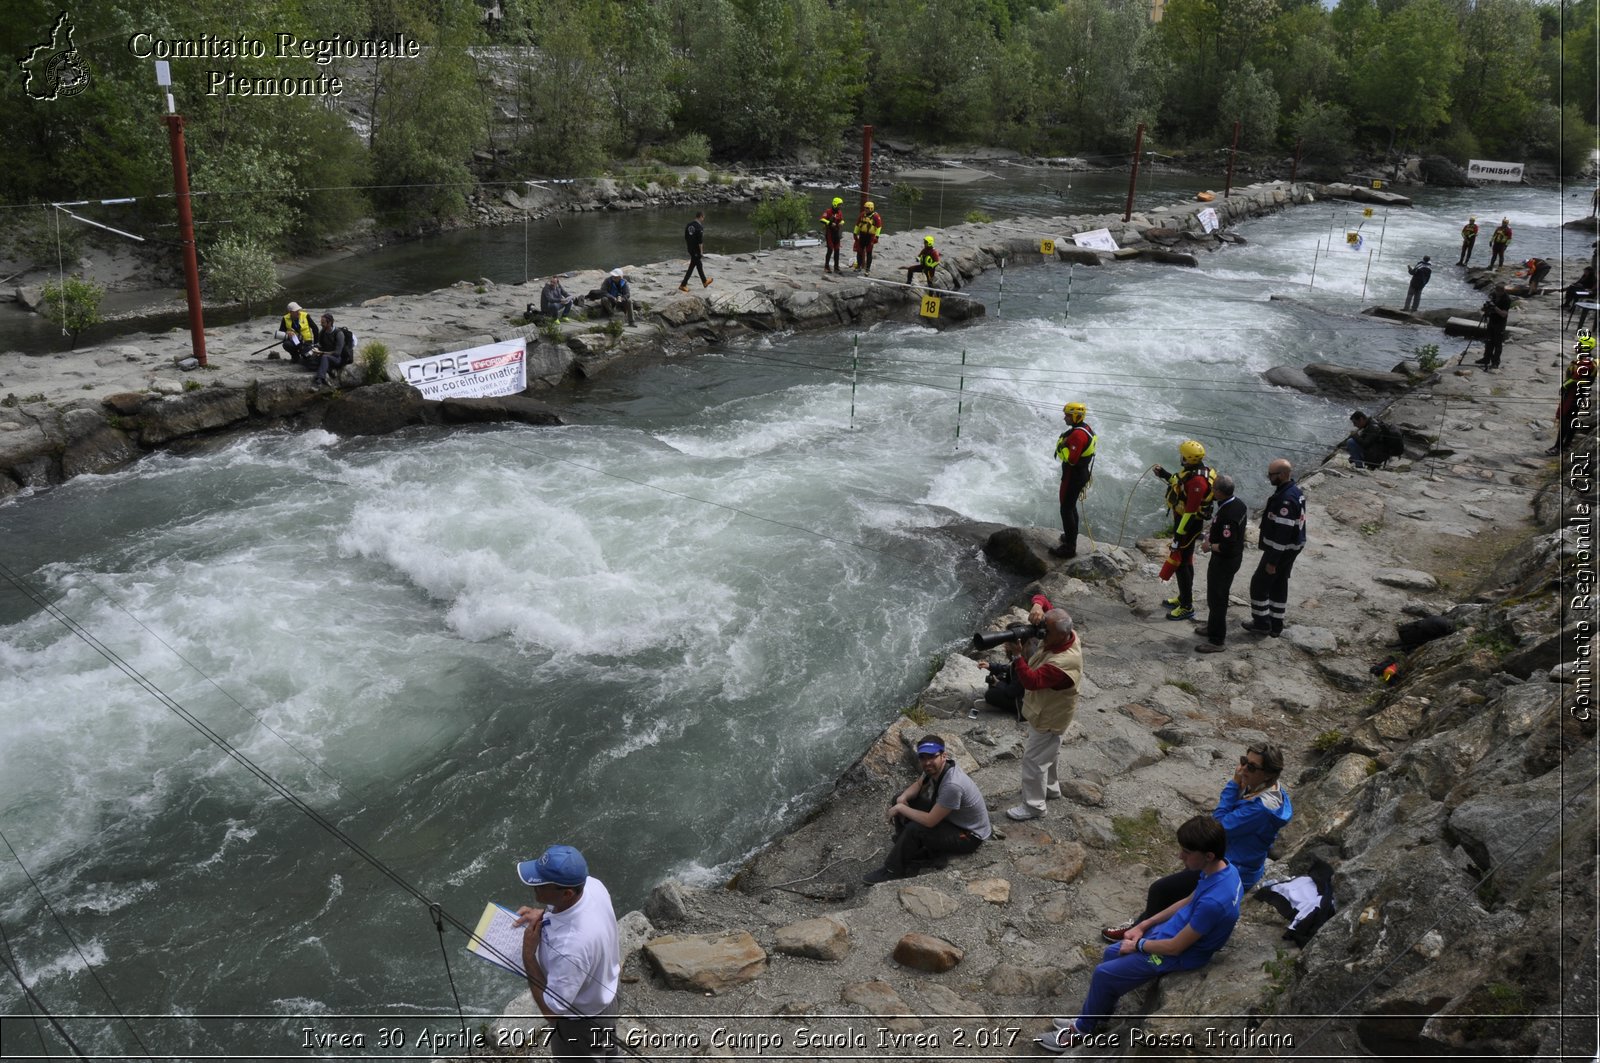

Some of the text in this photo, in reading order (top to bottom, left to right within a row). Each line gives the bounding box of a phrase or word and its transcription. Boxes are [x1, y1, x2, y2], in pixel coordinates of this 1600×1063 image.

[1480, 167, 1510, 175] FINISH
[1044, 242, 1052, 251] 19
[925, 300, 936, 313] 18
[407, 354, 470, 384] CORE
